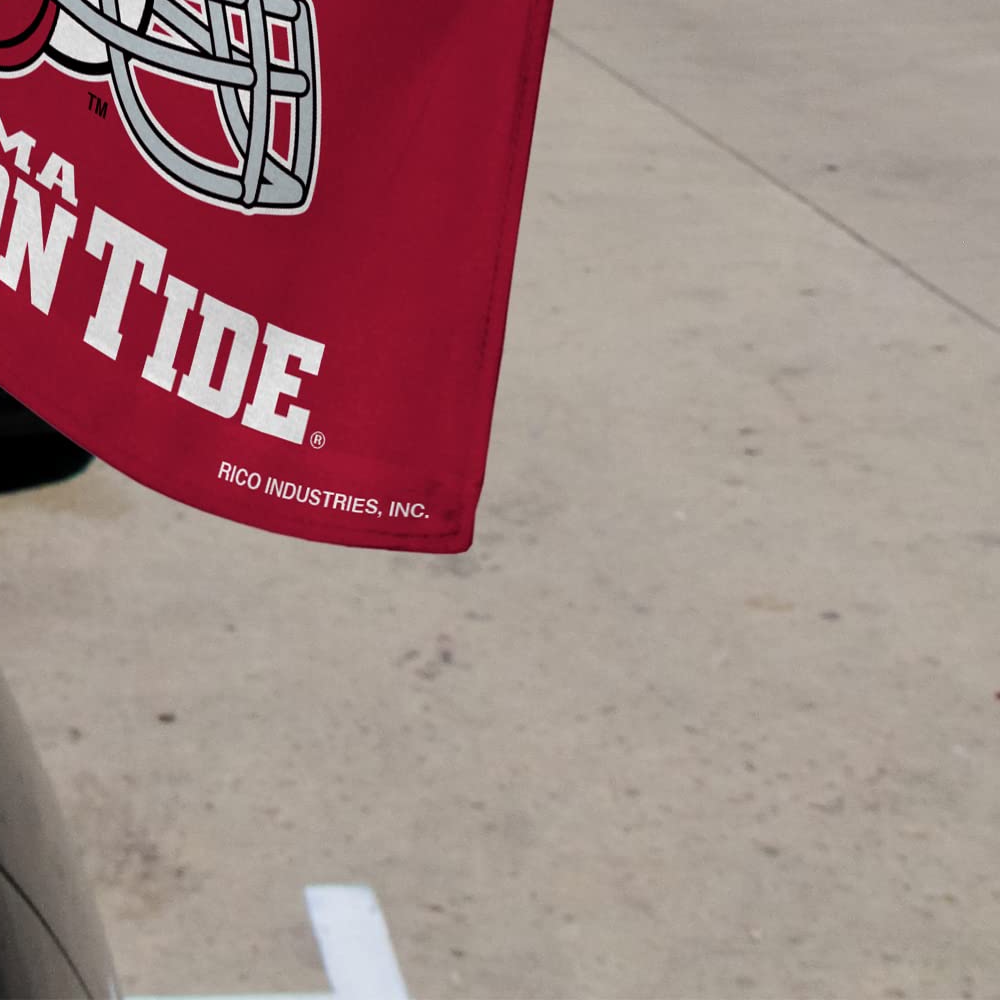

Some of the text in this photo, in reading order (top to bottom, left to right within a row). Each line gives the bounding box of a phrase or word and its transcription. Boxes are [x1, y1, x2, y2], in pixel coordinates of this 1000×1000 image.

[87, 90, 109, 119] TM
[83, 205, 326, 445] TIDE
[217, 460, 430, 519] RICO INDUSTRIES, INC.
